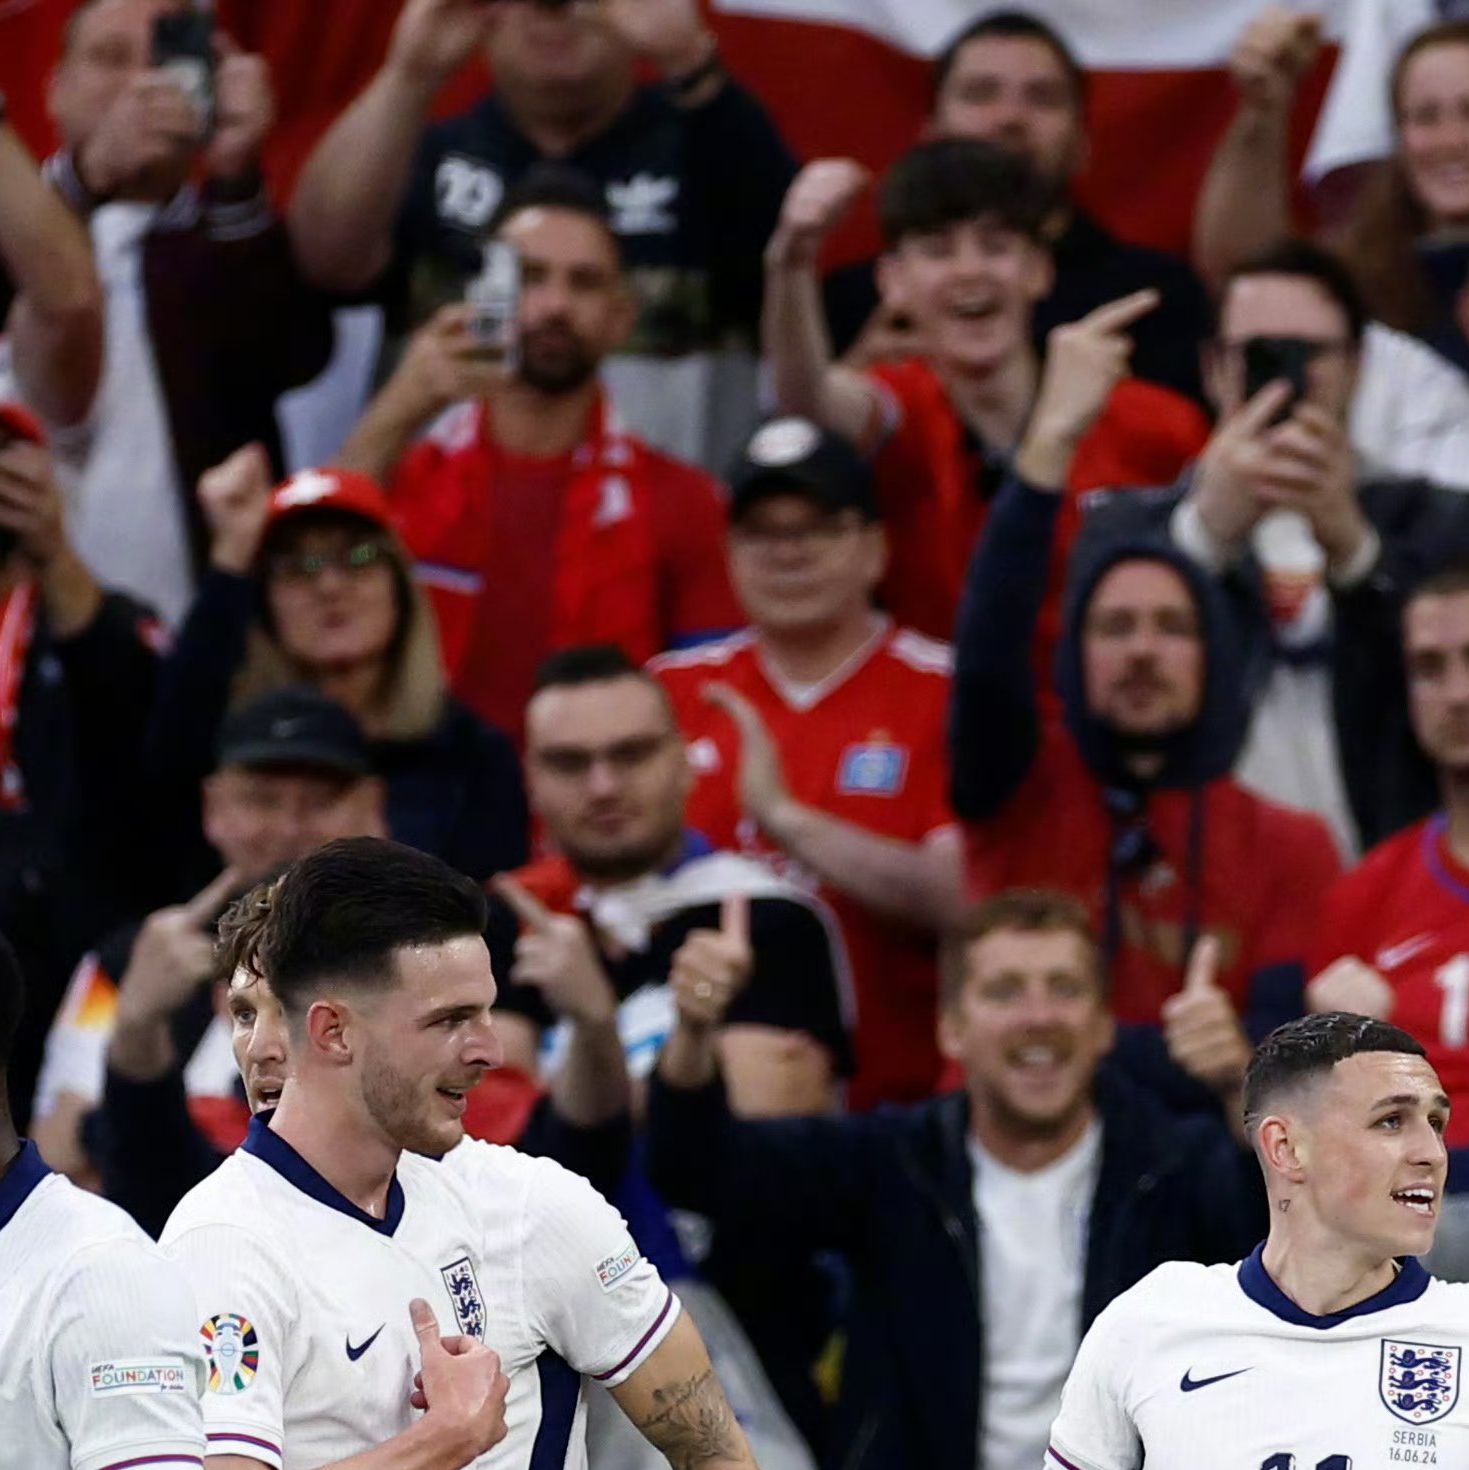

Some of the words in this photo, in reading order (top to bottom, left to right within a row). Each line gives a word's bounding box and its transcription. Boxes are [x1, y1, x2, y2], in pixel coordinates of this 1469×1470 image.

[92, 1368, 184, 1387] FOUNDATION
[1393, 1431, 1437, 1447] SERBIA
[1389, 1447, 1438, 1465] 16.06.24
